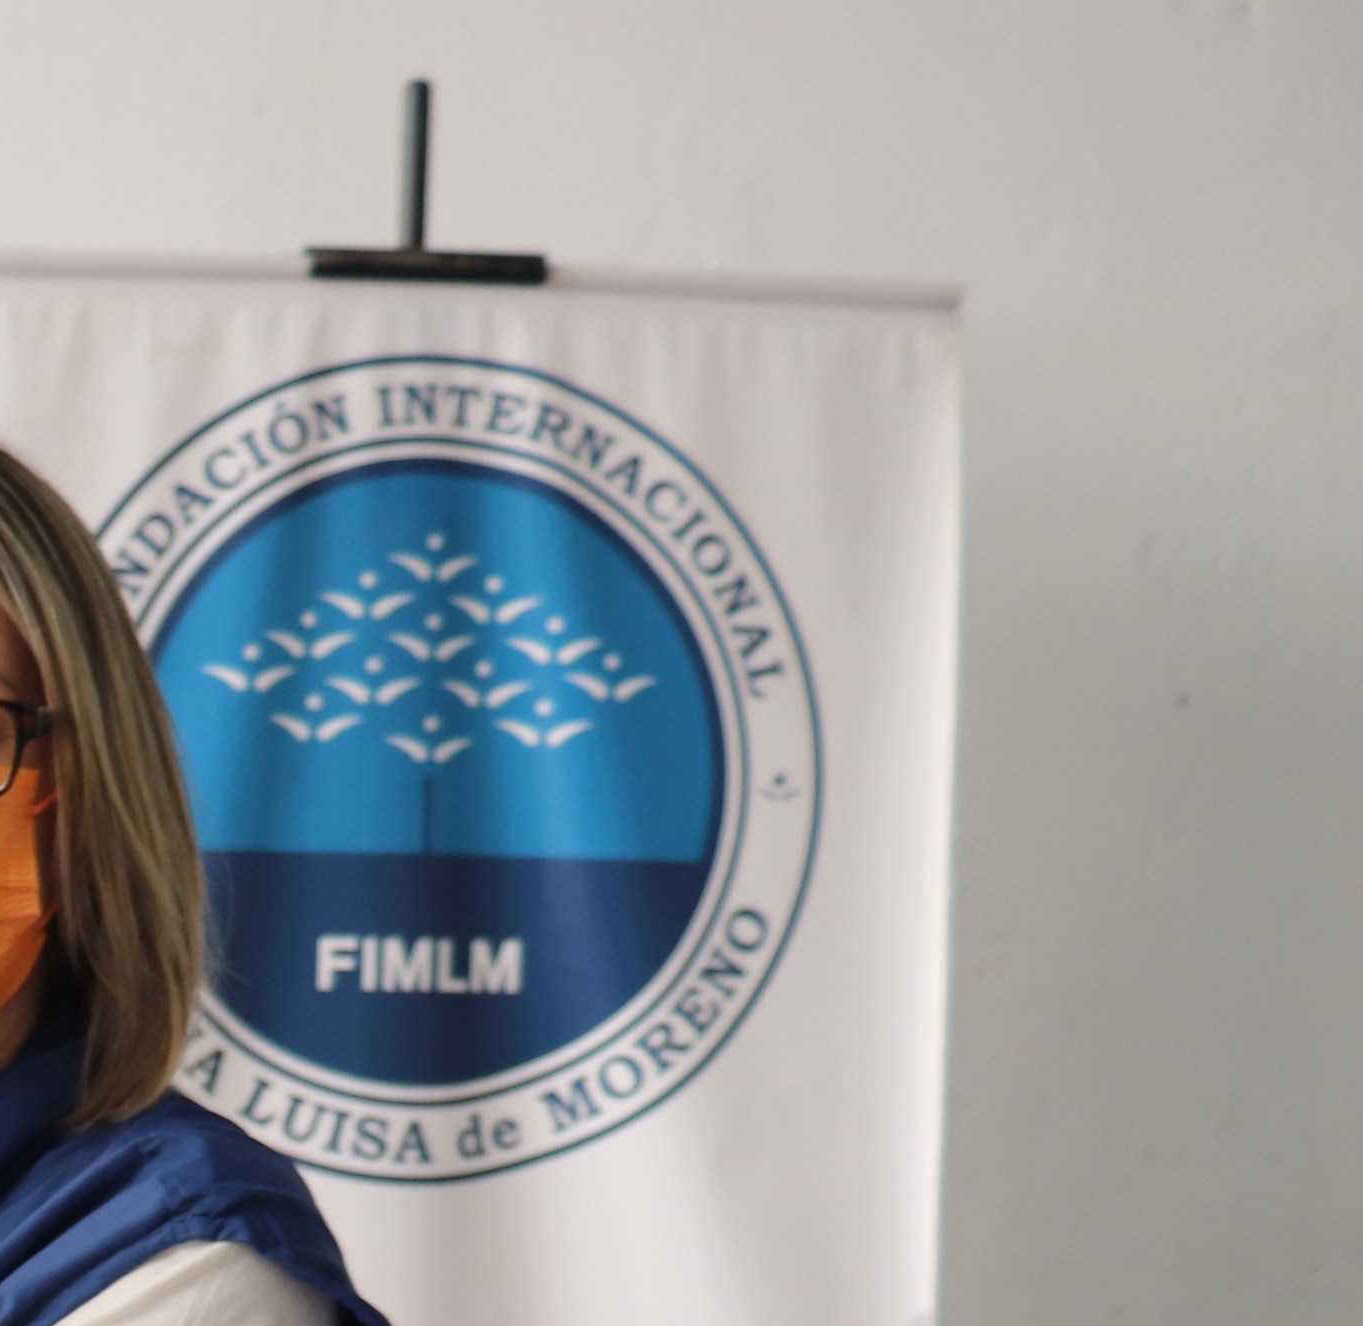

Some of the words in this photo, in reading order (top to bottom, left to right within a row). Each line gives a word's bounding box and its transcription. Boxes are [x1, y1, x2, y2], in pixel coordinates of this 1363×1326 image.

[112, 391, 355, 594] NDACIÓN
[375, 383, 787, 700] INTERNACIONAL
[237, 1077, 432, 1164] LUISA
[456, 1114, 521, 1160] de
[539, 907, 769, 1132] MORENO
[315, 935, 524, 995] FIMLM
